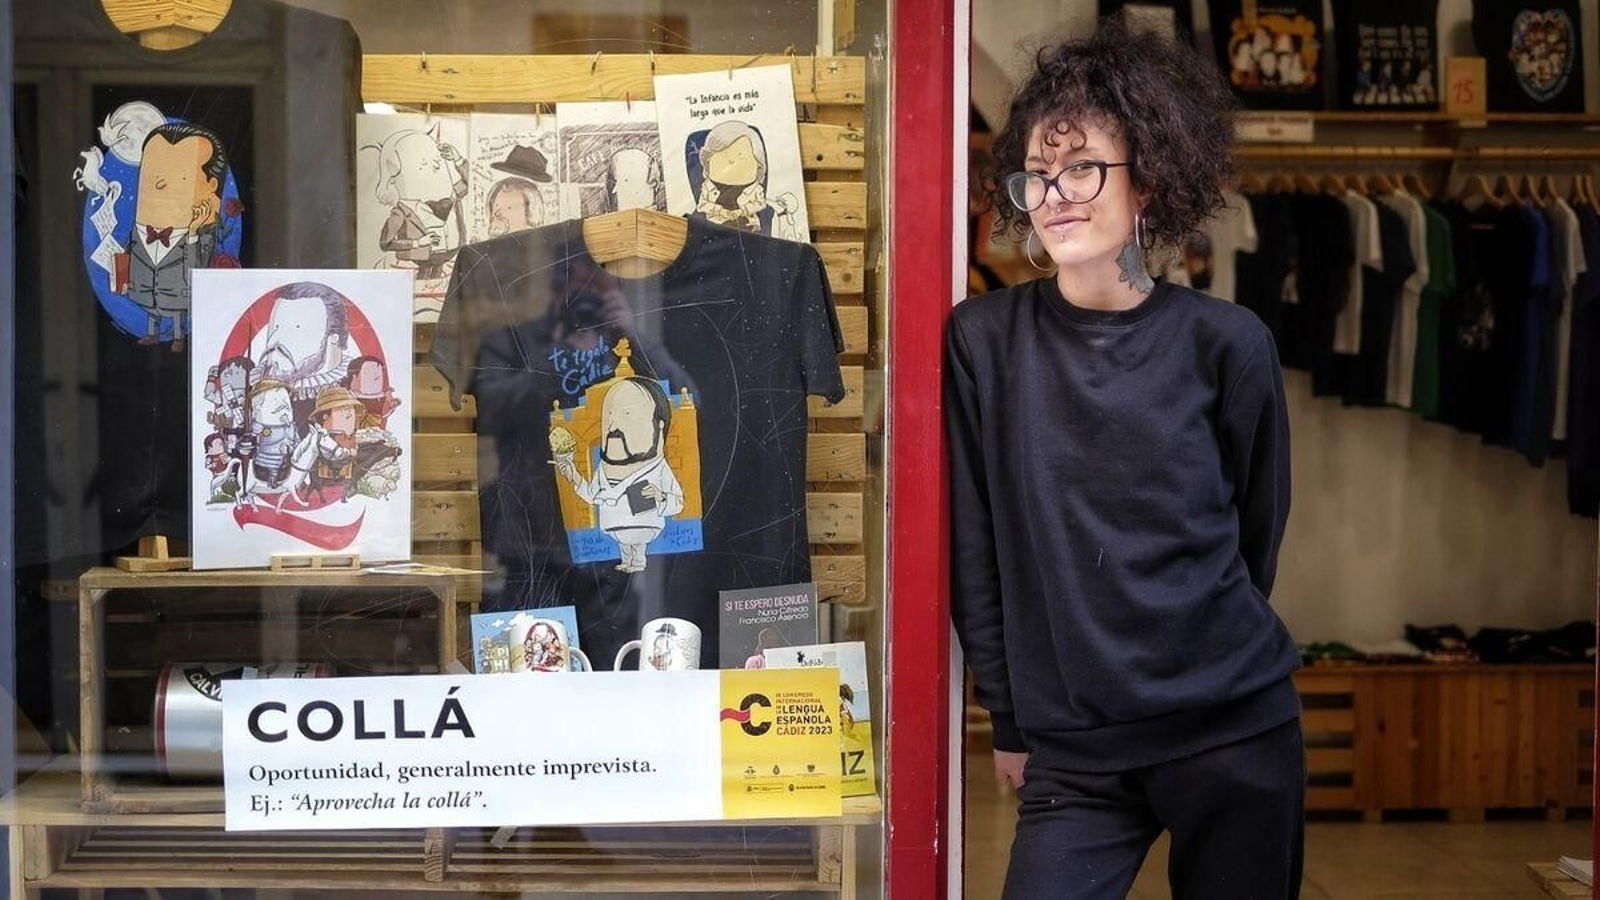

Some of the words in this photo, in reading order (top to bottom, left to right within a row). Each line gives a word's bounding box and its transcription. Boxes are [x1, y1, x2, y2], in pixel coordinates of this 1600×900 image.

[700, 93, 730, 103] Infancia
[733, 93, 742, 101] es
[744, 89, 759, 99] más
[690, 108, 709, 120] larga
[712, 108, 725, 116] que
[728, 105, 735, 113] la
[572, 336, 609, 368] regalo
[562, 364, 613, 394] Cádiz
[725, 601, 733, 612] SI
[734, 600, 745, 611] TE
[745, 598, 774, 610] ESPERO
[774, 594, 809, 607] DESNUDA
[758, 607, 778, 616] Nuria
[779, 605, 809, 615] Cifredo
[739, 615, 776, 625] Francisco
[778, 611, 809, 621] Asencio
[247, 685, 476, 742] COLLÁ
[782, 704, 825, 715] LENGUA
[776, 713, 831, 725] ESPAÑOLA
[809, 726, 833, 735] 2023
[248, 761, 391, 786] Oportunidad,
[398, 760, 536, 784] generalmente
[543, 757, 657, 780] imprevista.
[250, 794, 283, 816] Ej.:
[291, 791, 396, 815] “Aprovecha
[402, 791, 420, 809] la
[427, 790, 488, 809] collá”.
